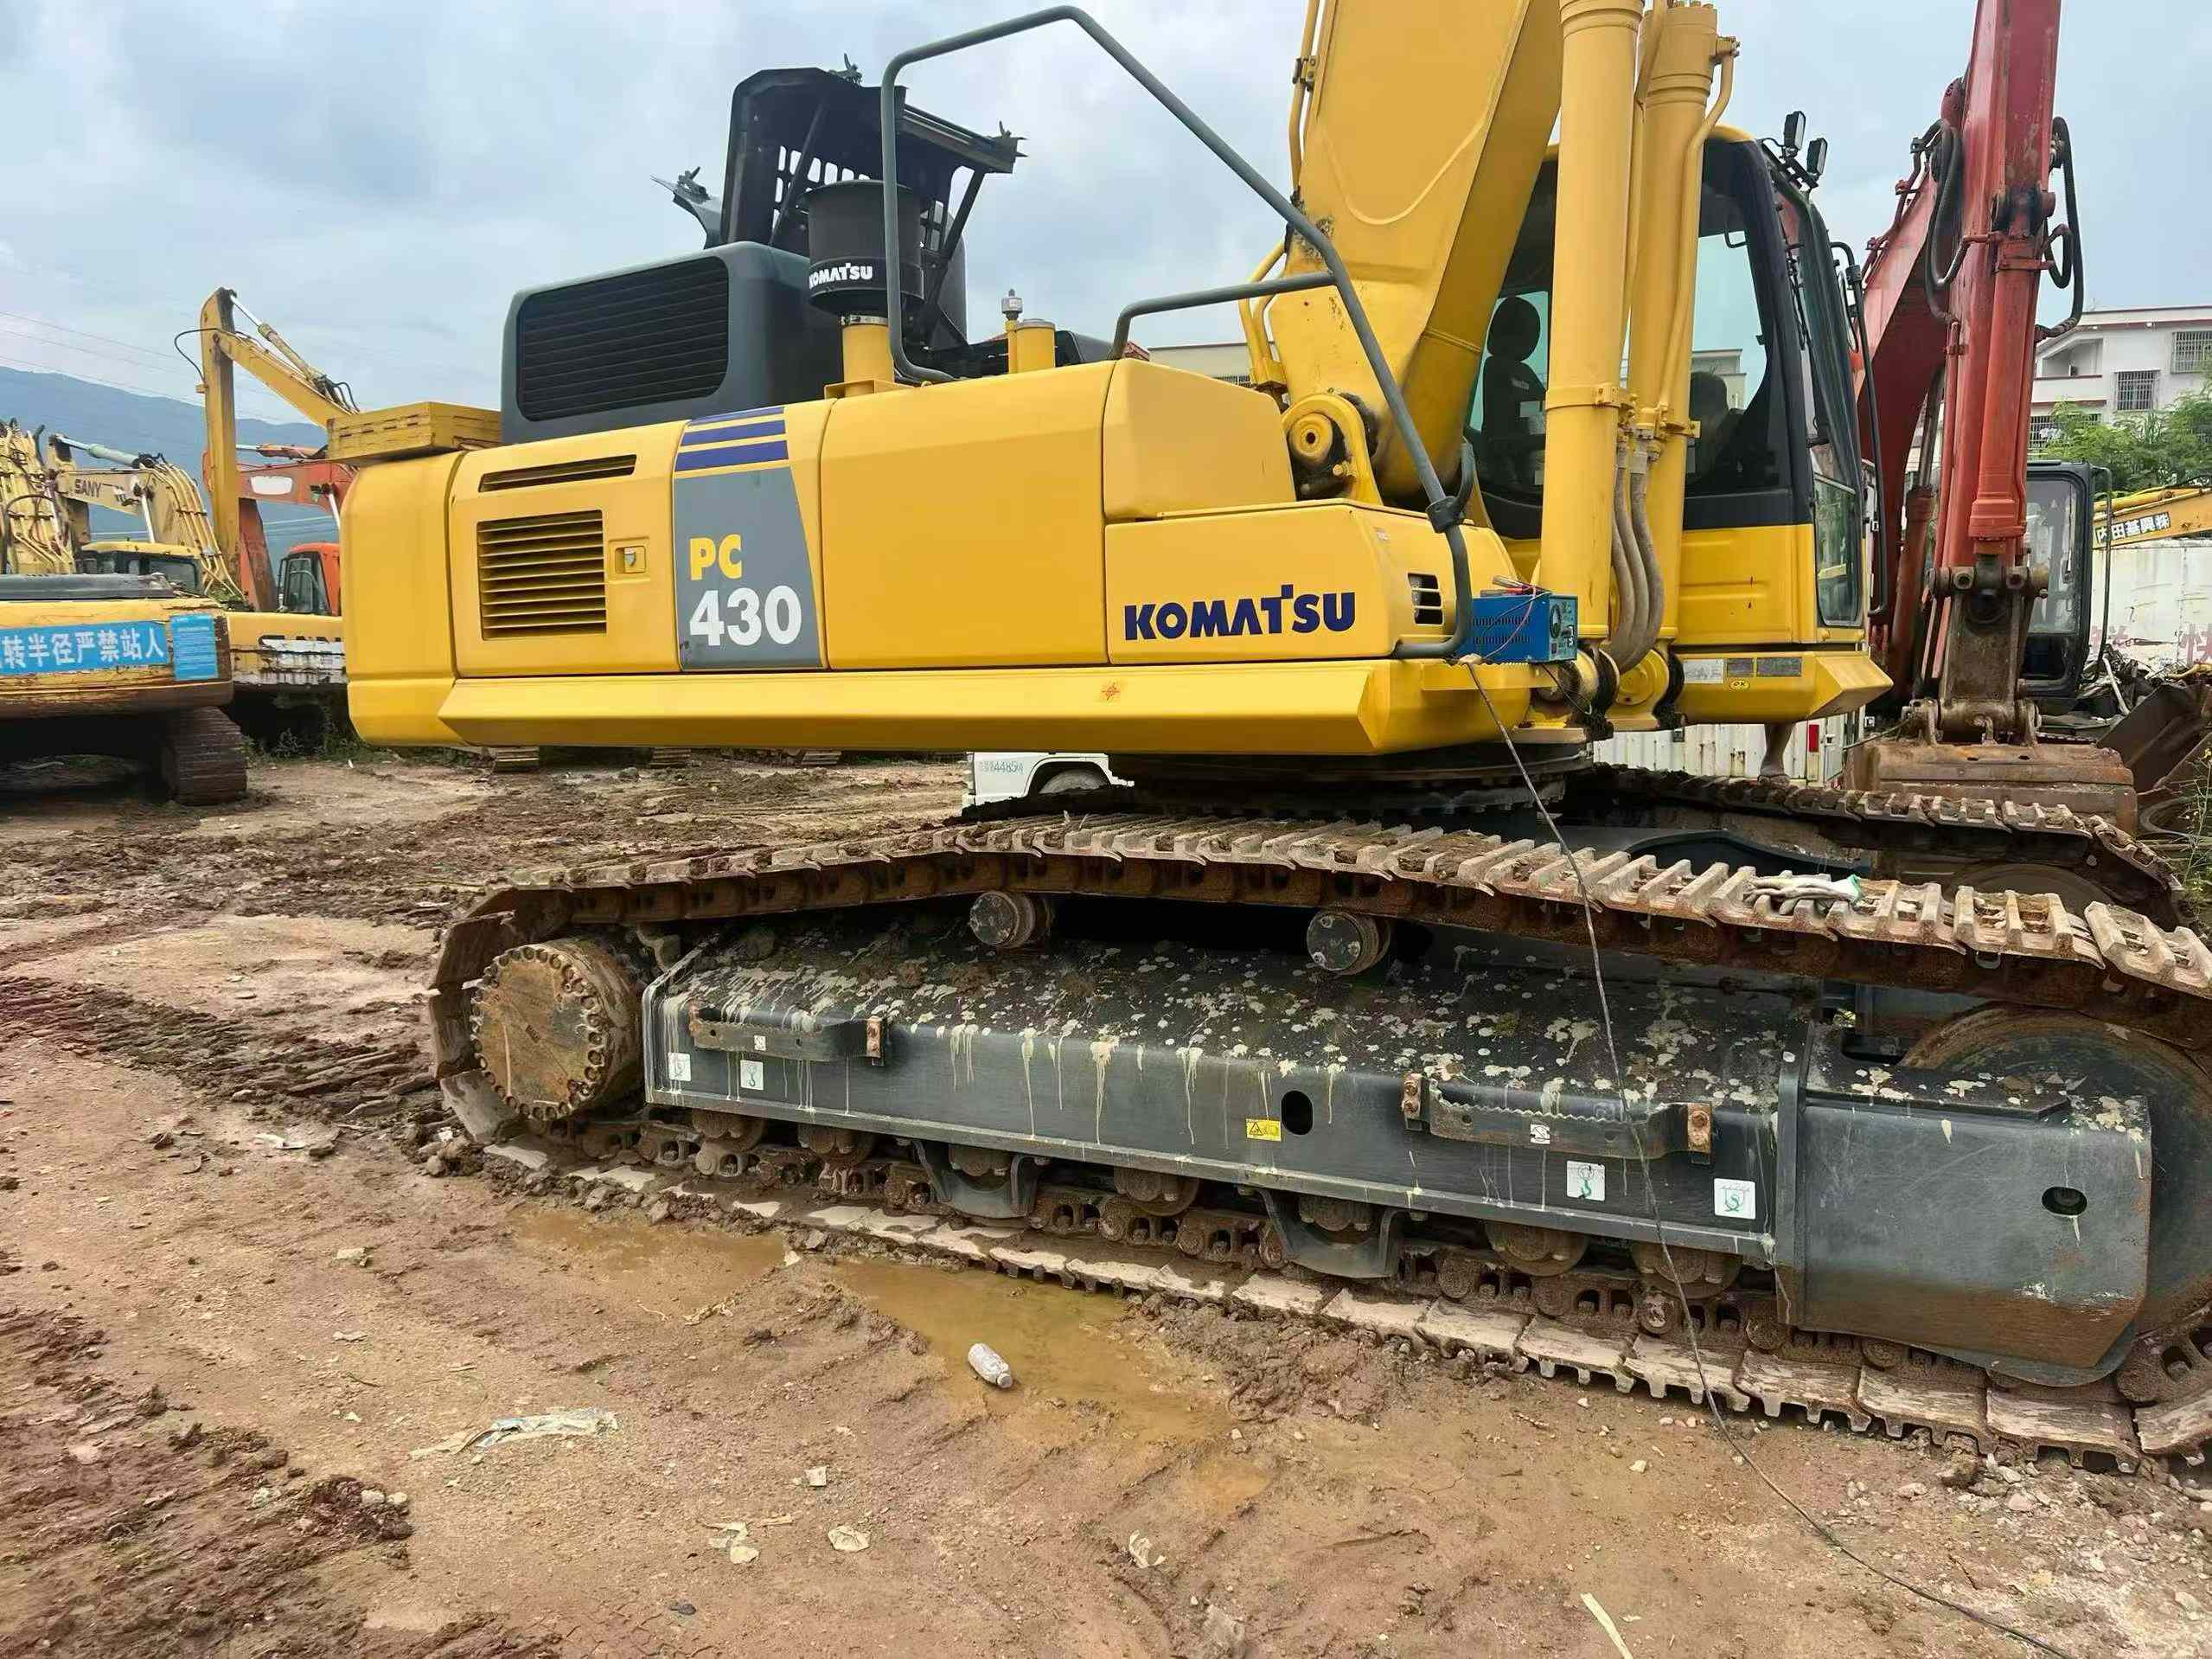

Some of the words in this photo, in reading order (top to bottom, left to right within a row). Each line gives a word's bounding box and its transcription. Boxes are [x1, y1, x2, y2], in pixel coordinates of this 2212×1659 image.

[809, 262, 873, 289] KOMATSU
[75, 478, 102, 498] SANY
[688, 534, 742, 580] PC
[689, 585, 802, 646] 430
[1124, 584, 1356, 641] KOMATSU
[2, 628, 164, 669] 转半径严禁站人
